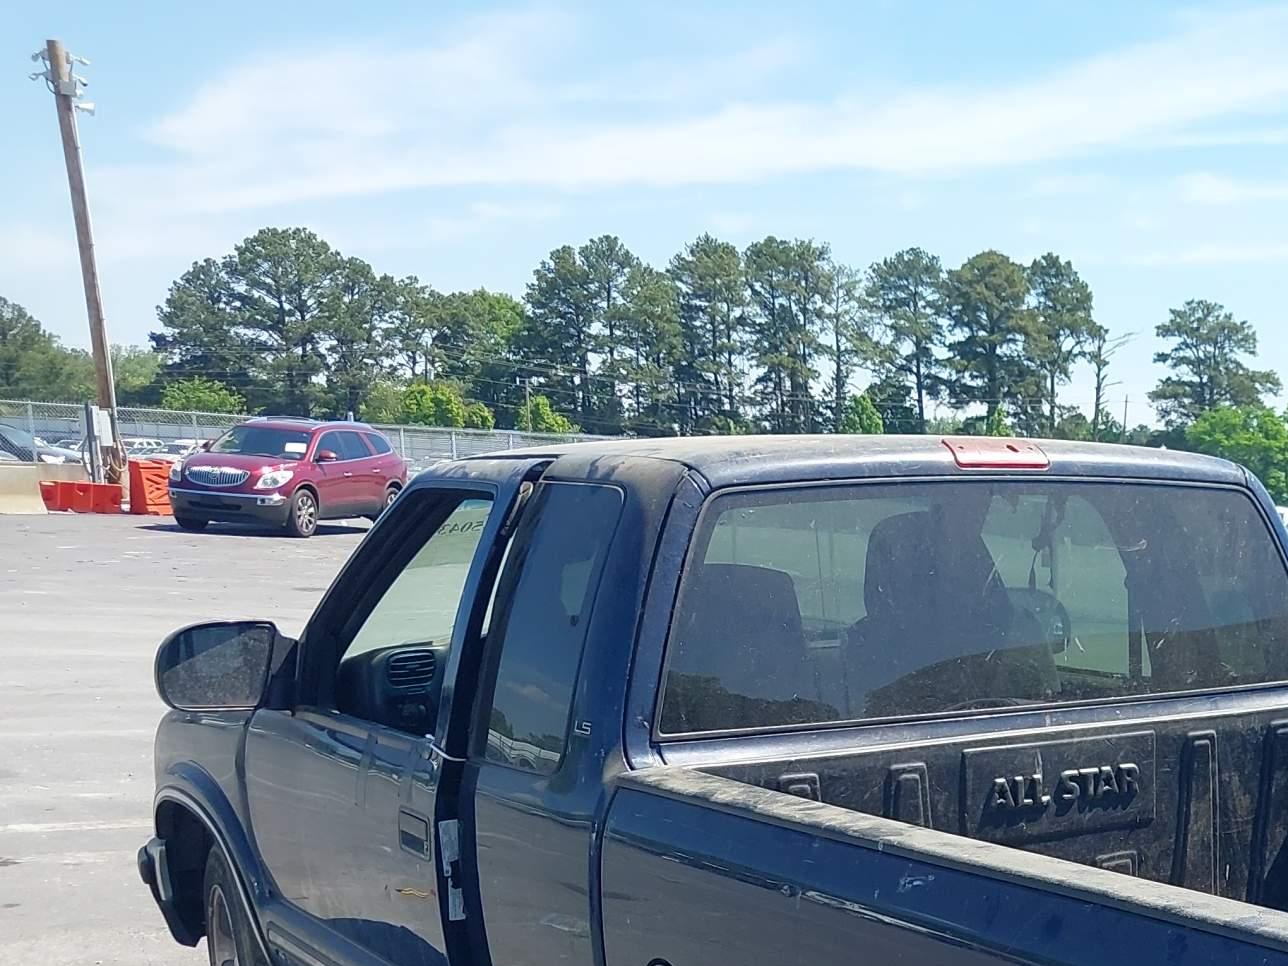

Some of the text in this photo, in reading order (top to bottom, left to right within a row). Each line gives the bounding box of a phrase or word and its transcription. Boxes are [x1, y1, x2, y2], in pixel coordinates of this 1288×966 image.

[573, 720, 592, 735] LS
[993, 762, 1140, 808] ALL STAR
